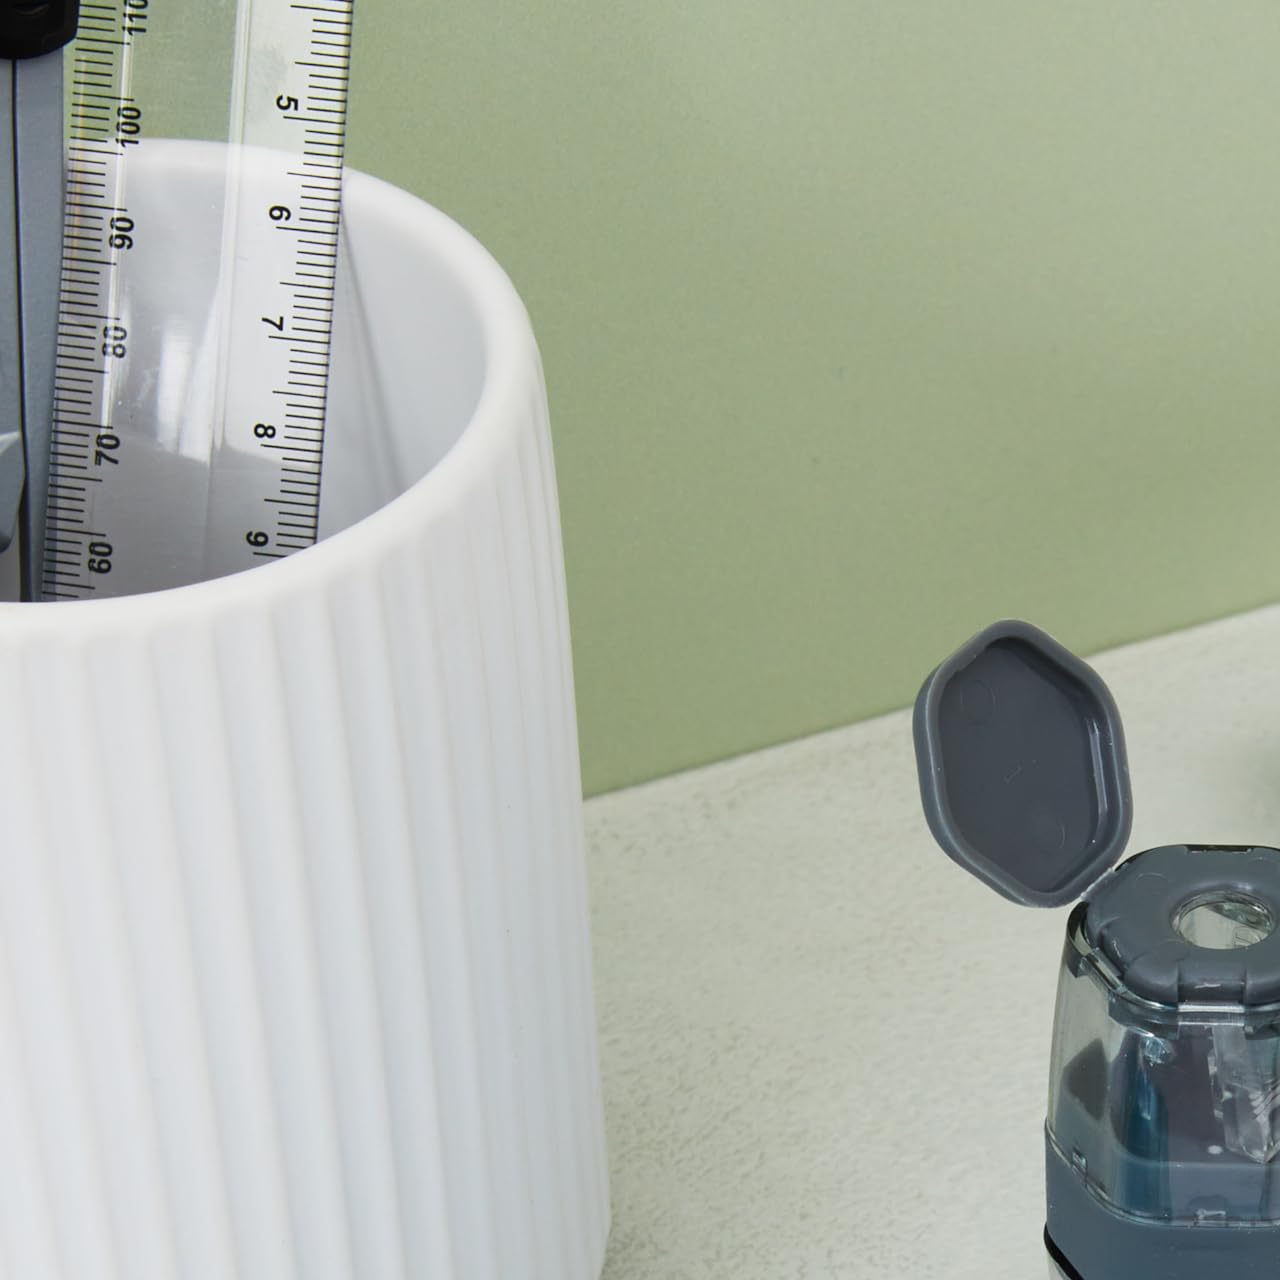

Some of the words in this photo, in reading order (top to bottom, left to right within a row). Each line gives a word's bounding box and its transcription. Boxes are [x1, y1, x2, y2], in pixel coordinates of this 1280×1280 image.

[276, 95, 299, 111] 5
[115, 106, 141, 147] 100
[268, 205, 291, 221] 6
[109, 216, 134, 250] 90
[261, 316, 284, 331] 7
[102, 325, 127, 358] 80
[254, 423, 277, 438] 8
[94, 433, 121, 466] 70
[246, 531, 269, 547] 9
[87, 541, 113, 574] 60
